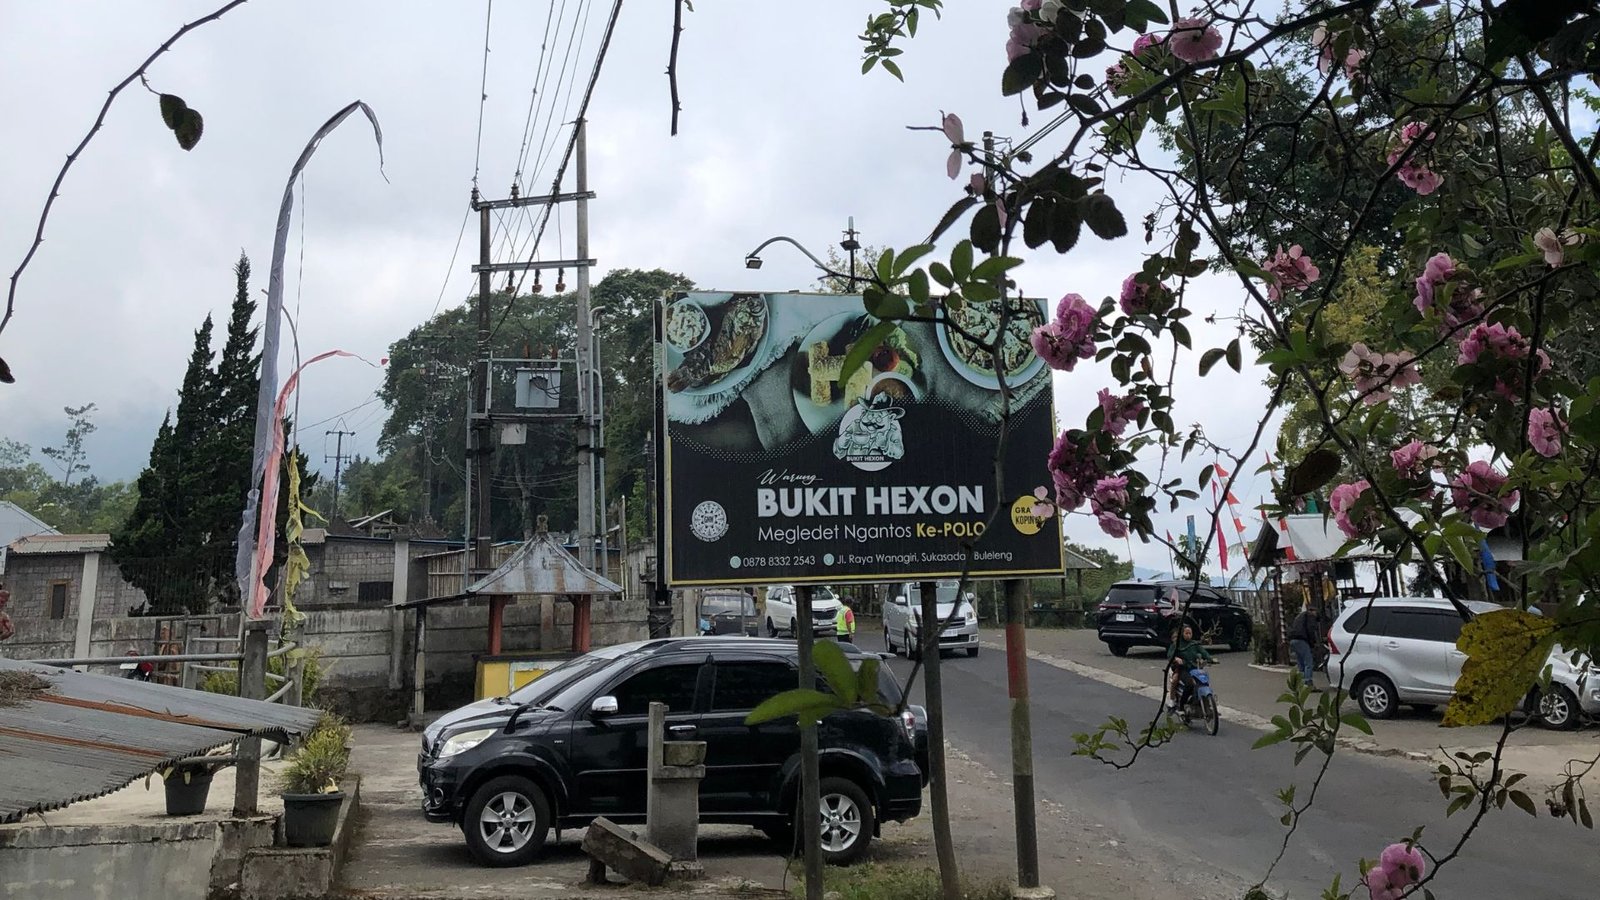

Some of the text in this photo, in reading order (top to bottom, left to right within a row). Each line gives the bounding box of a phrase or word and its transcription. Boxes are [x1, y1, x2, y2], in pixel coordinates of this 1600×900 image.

[756, 468, 823, 486] Warung
[757, 485, 985, 518] BUKIT HEXON
[758, 521, 986, 544] Megledet Ngantos Ke-POLO
[743, 555, 816, 567] 0878 8332 2543
[849, 554, 874, 565] Raya
[875, 552, 920, 565] Wanagiri,
[921, 552, 967, 562] Sukasada
[974, 551, 1013, 562] Buleleng
